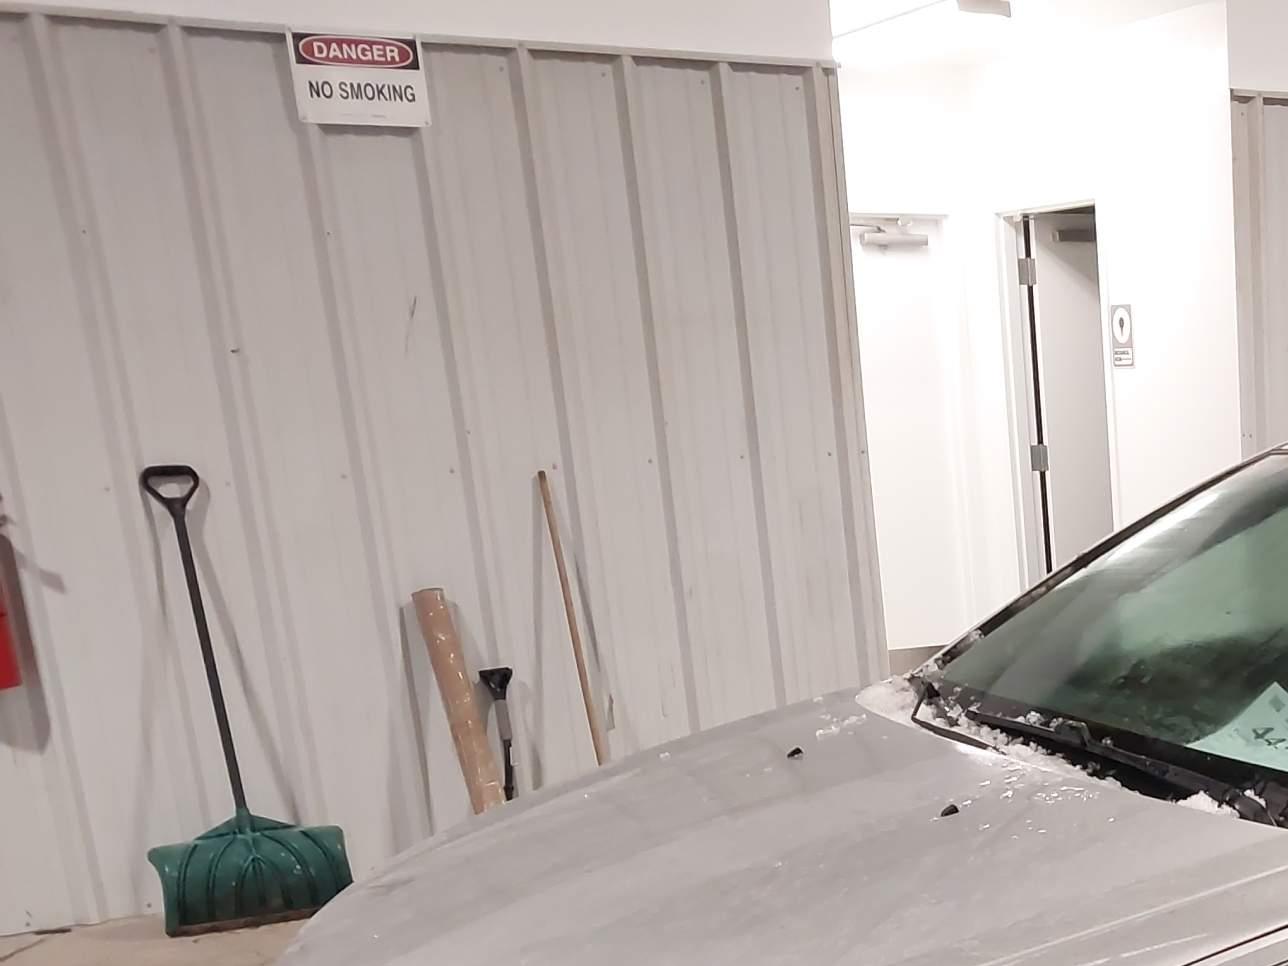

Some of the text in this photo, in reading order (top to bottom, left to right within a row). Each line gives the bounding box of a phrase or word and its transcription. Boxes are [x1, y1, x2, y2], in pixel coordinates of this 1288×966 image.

[312, 41, 400, 62] DANGER
[308, 80, 416, 103] NO SMOKING
